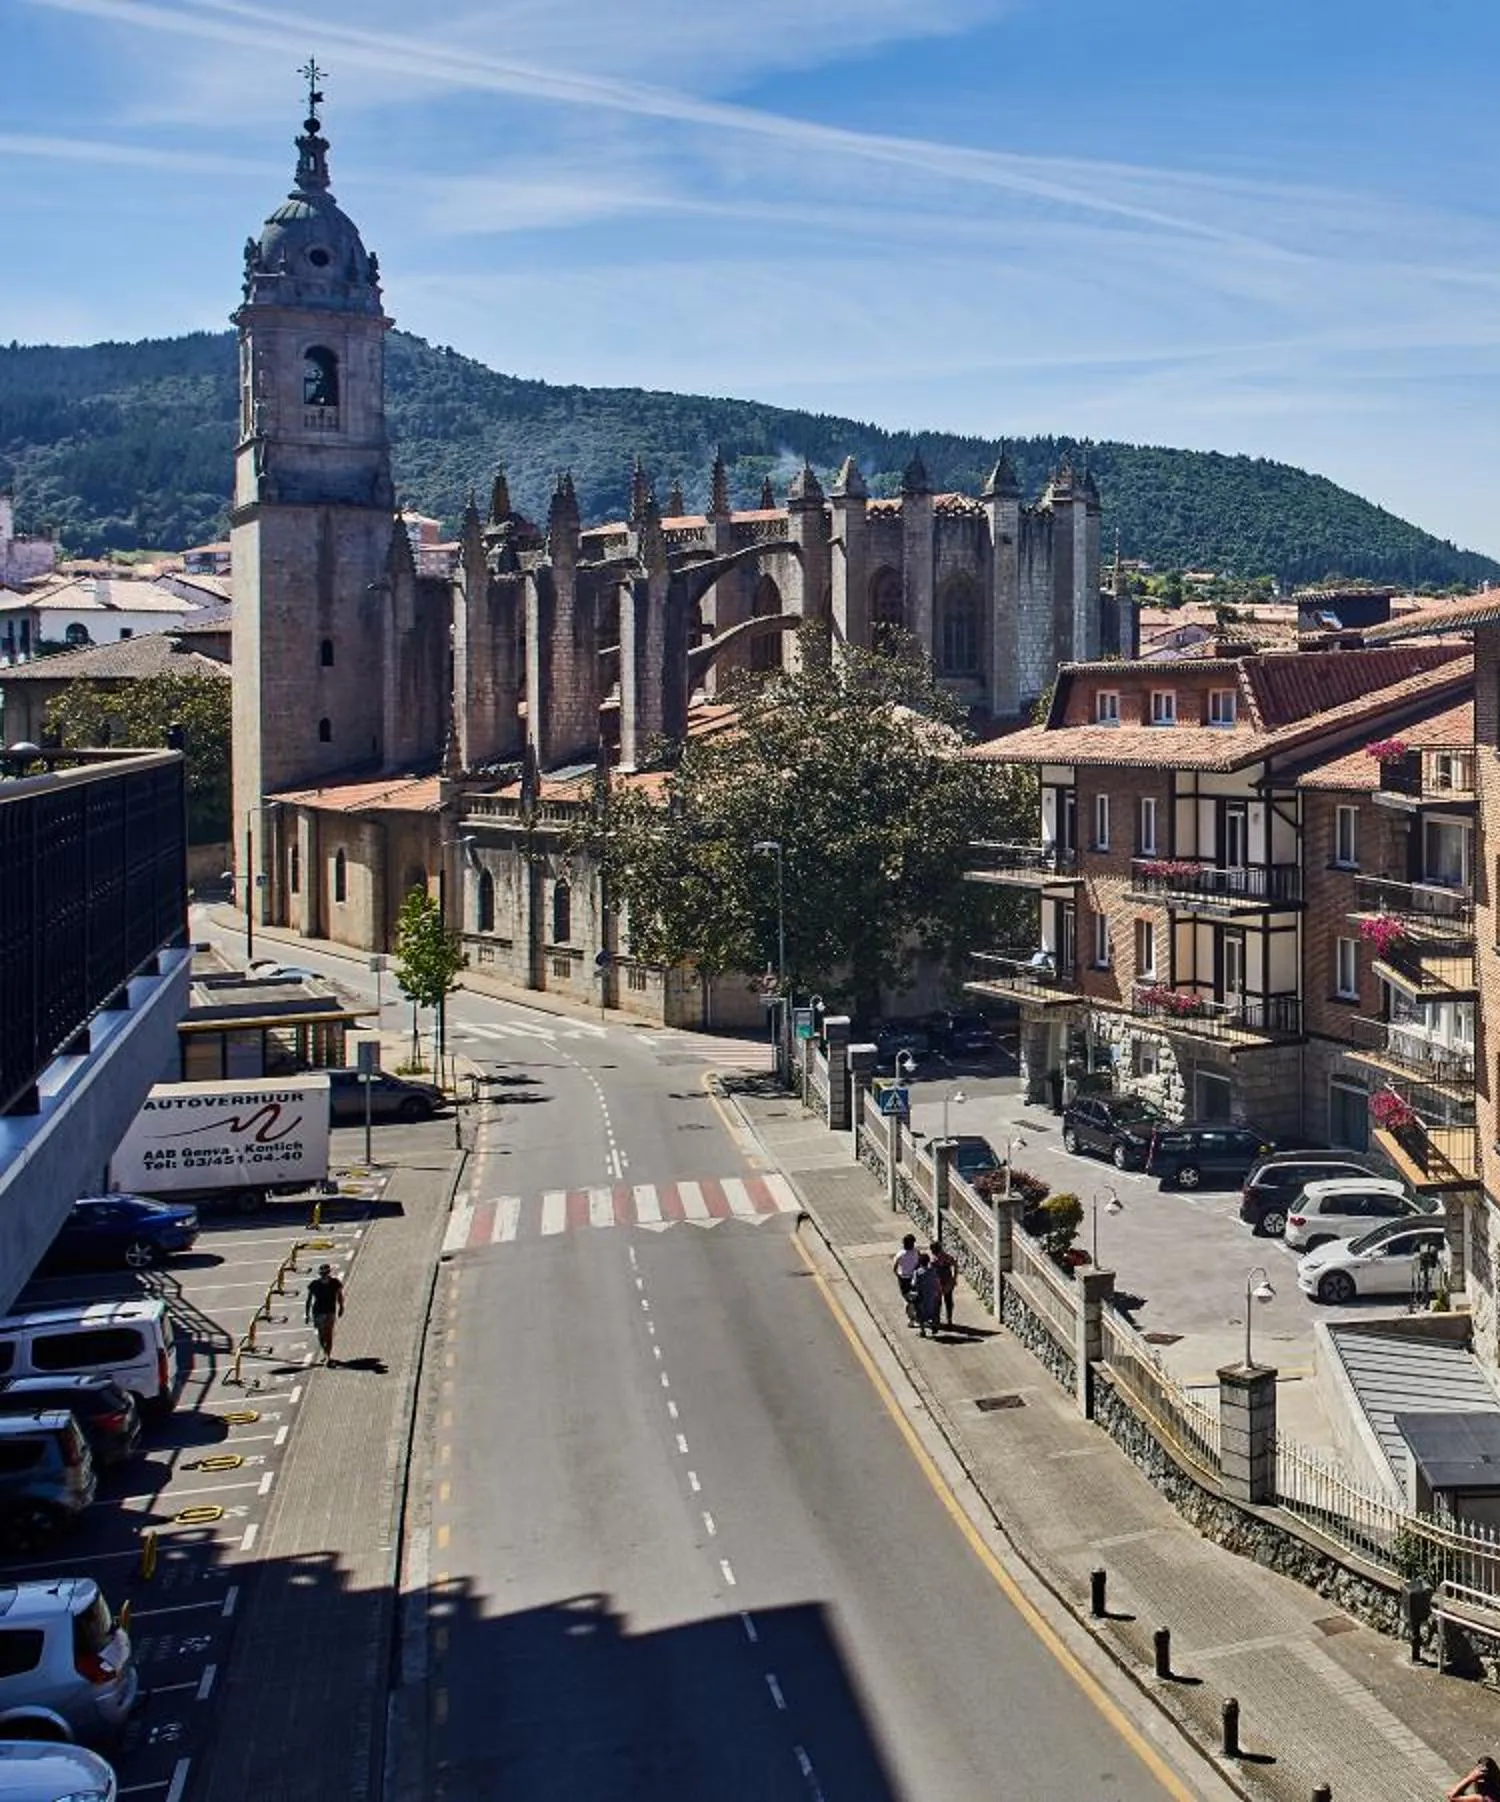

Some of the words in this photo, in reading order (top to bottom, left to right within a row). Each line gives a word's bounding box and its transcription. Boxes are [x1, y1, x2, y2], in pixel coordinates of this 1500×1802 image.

[143, 1093, 304, 1111] AUTOVERHUUR
[143, 1149, 177, 1161] AAB
[245, 1141, 303, 1154] Kontich
[143, 1159, 177, 1171] Tel:
